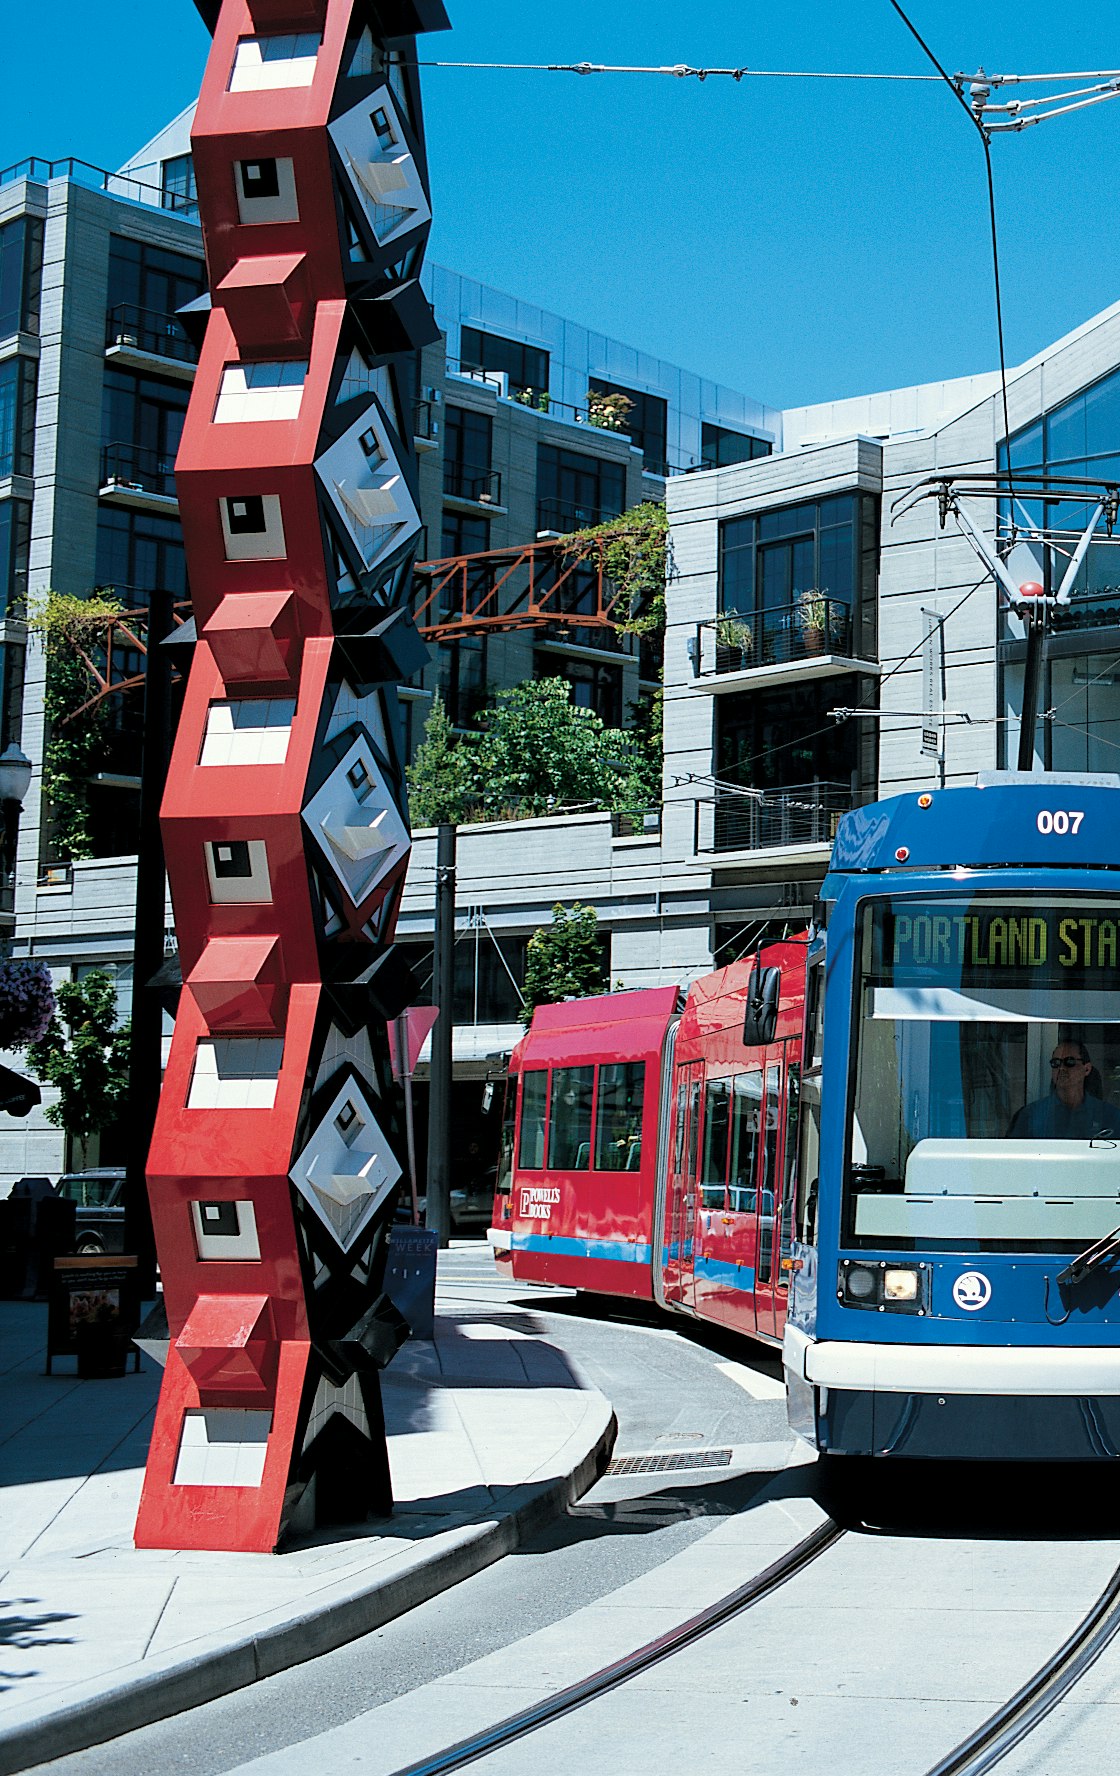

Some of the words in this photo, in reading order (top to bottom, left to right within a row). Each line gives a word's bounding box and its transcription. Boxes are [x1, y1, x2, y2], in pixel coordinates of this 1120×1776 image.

[1036, 810, 1085, 835] 007
[894, 914, 1048, 967] PORTLAND
[530, 1203, 552, 1219] BOOKS
[395, 1243, 432, 1252] WEEK
